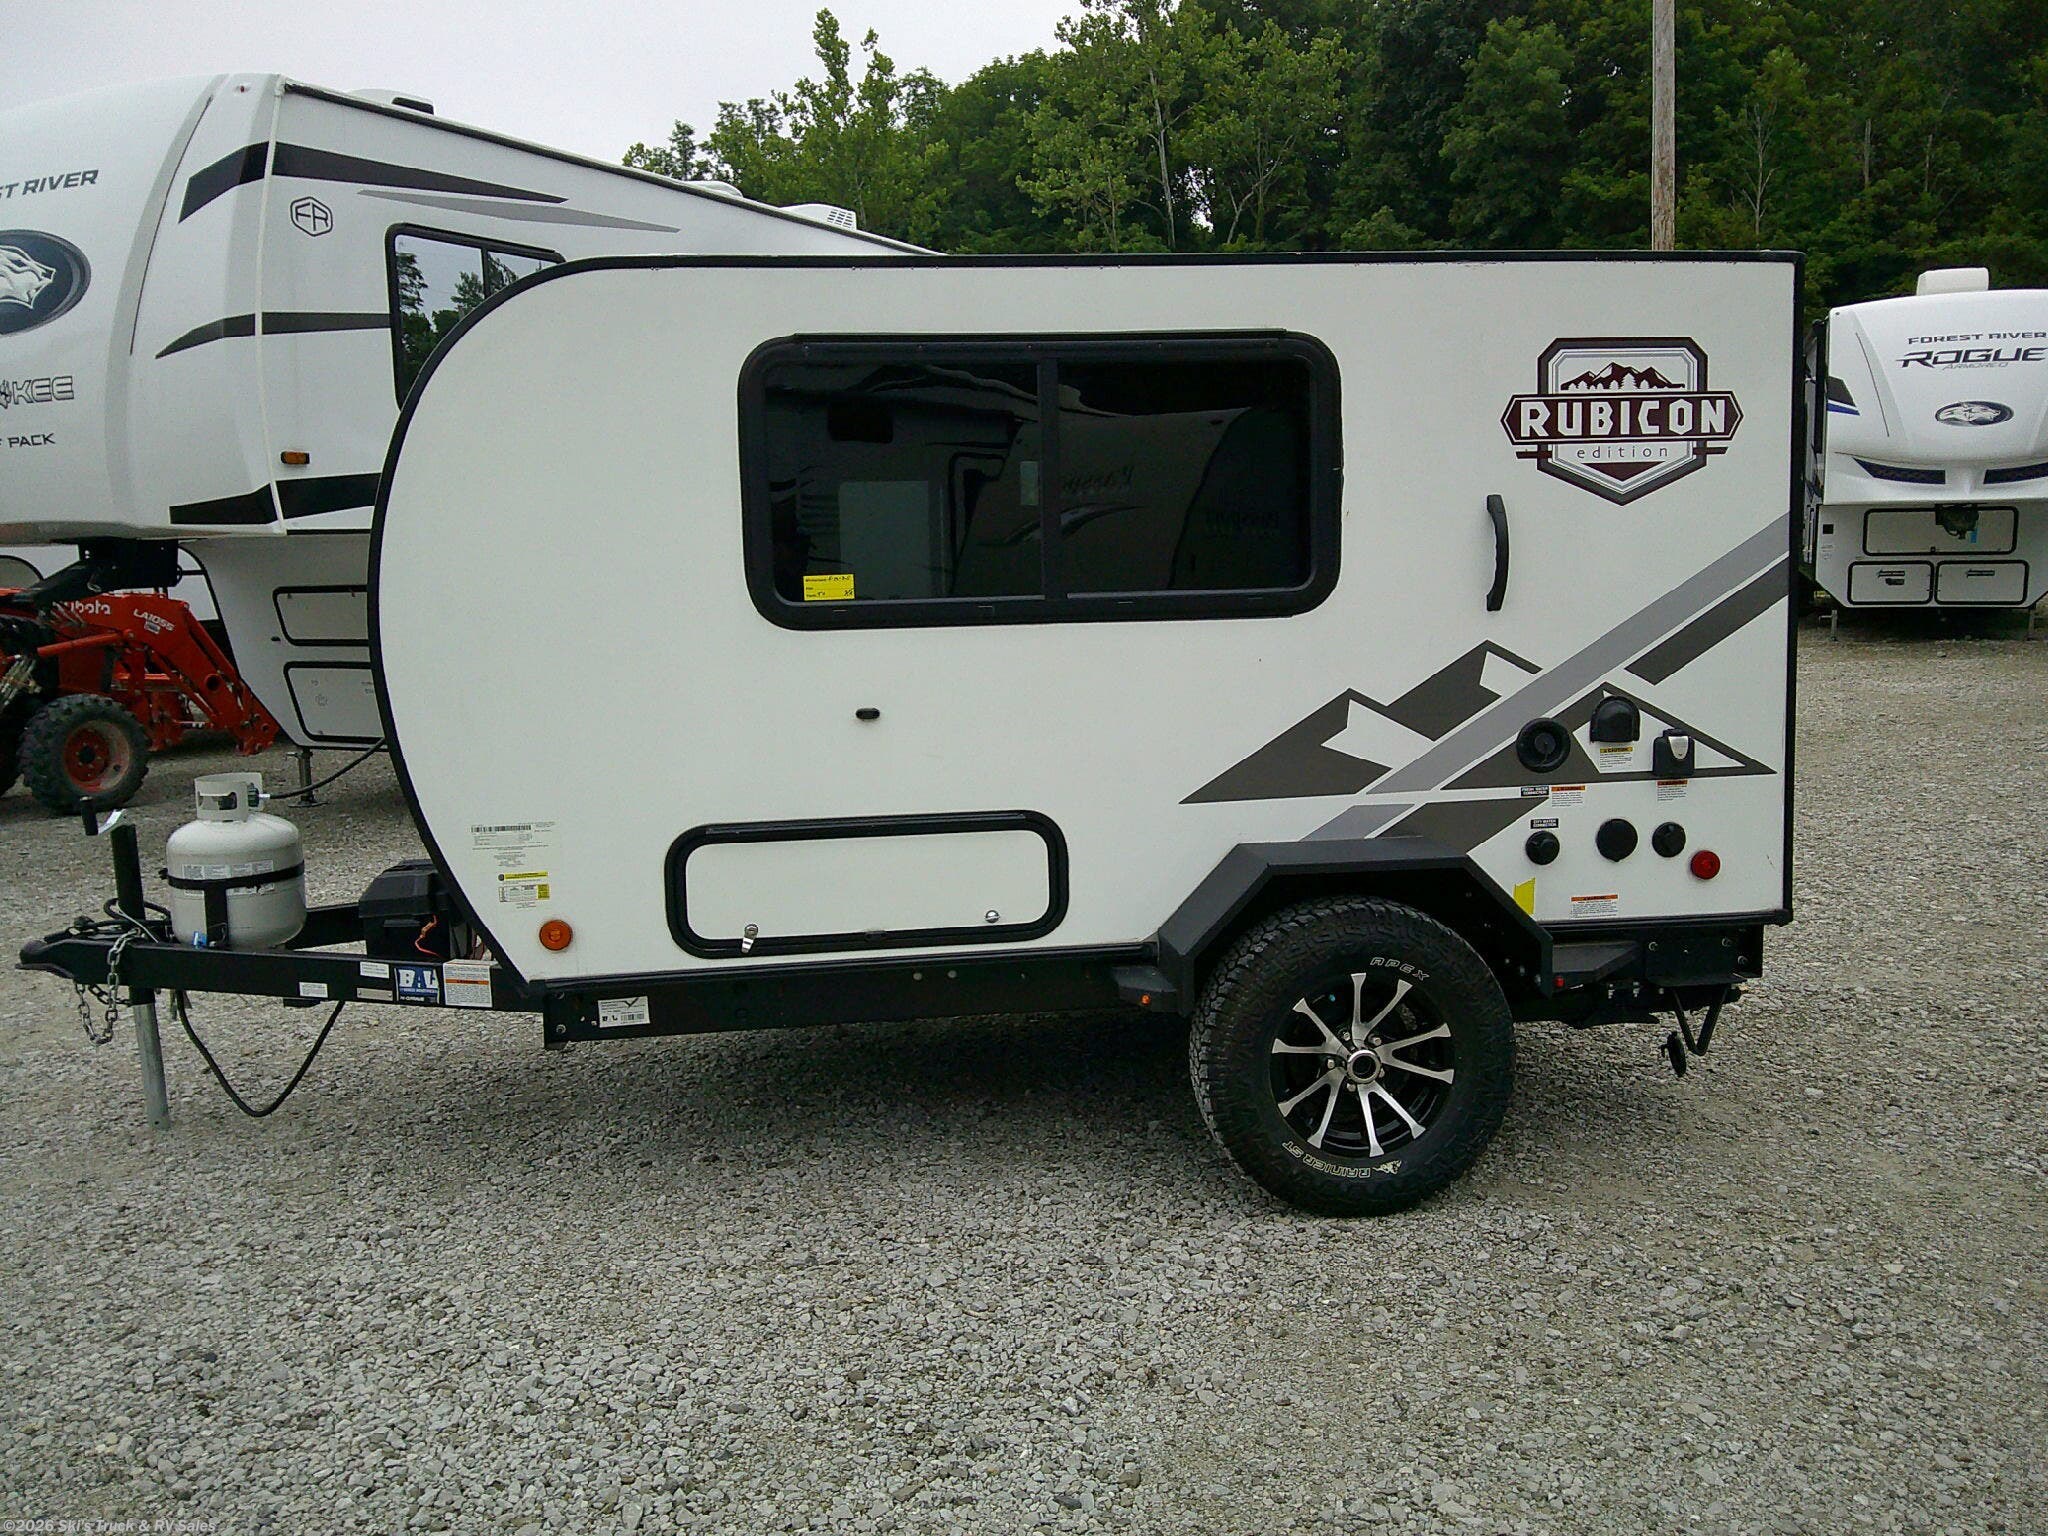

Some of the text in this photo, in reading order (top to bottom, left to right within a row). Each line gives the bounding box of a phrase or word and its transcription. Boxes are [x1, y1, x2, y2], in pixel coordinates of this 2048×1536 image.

[22, 169, 99, 195] RIVER
[1908, 331, 2047, 344] FOREST RIVER
[1896, 348, 2048, 368] ROGUE
[1520, 398, 1725, 437] RUBICON
[8, 433, 56, 448] PACK
[1577, 446, 1668, 459] edition
[1370, 956, 1430, 981] APEX
[1282, 1140, 1370, 1178] RAINIER ST
